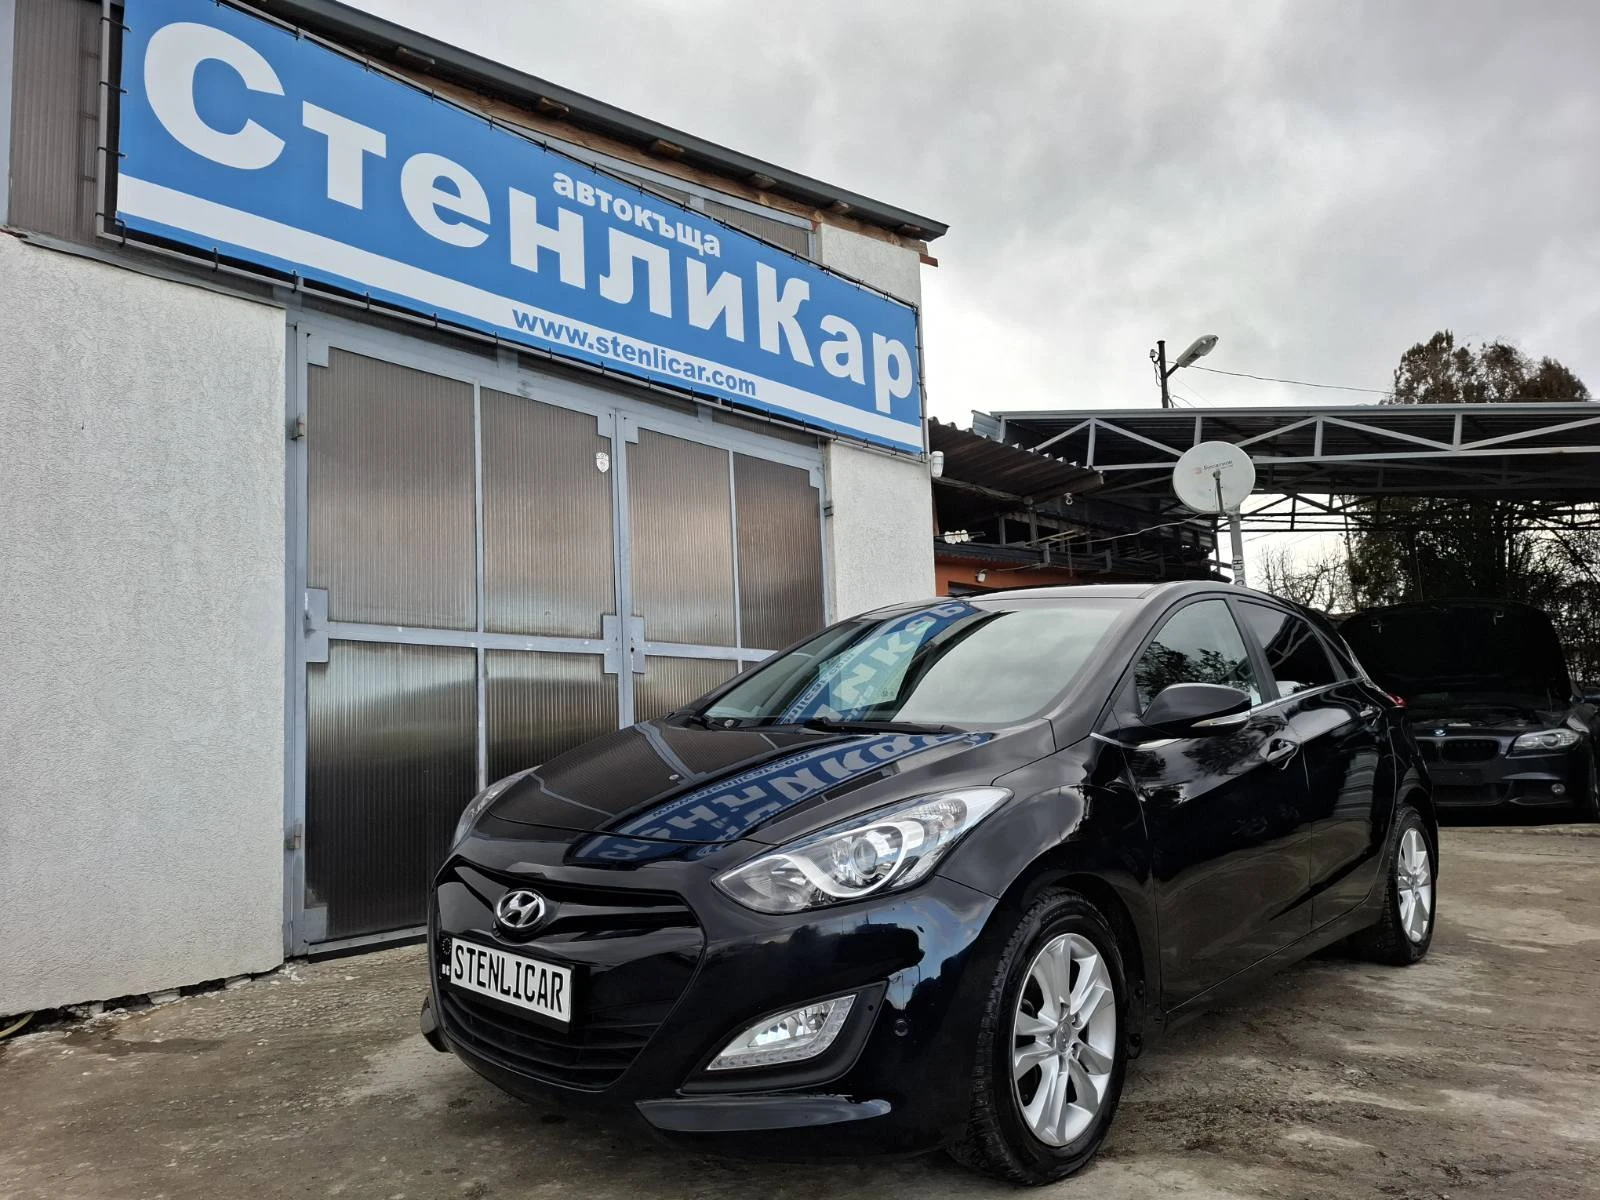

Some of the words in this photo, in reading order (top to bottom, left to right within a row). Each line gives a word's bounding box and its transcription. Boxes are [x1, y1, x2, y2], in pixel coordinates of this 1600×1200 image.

[144, 22, 913, 414] СтенлиКар
[553, 171, 721, 258] автокъща
[512, 309, 757, 397] www.stenlicar.com
[454, 945, 564, 1013] STENLICAR
